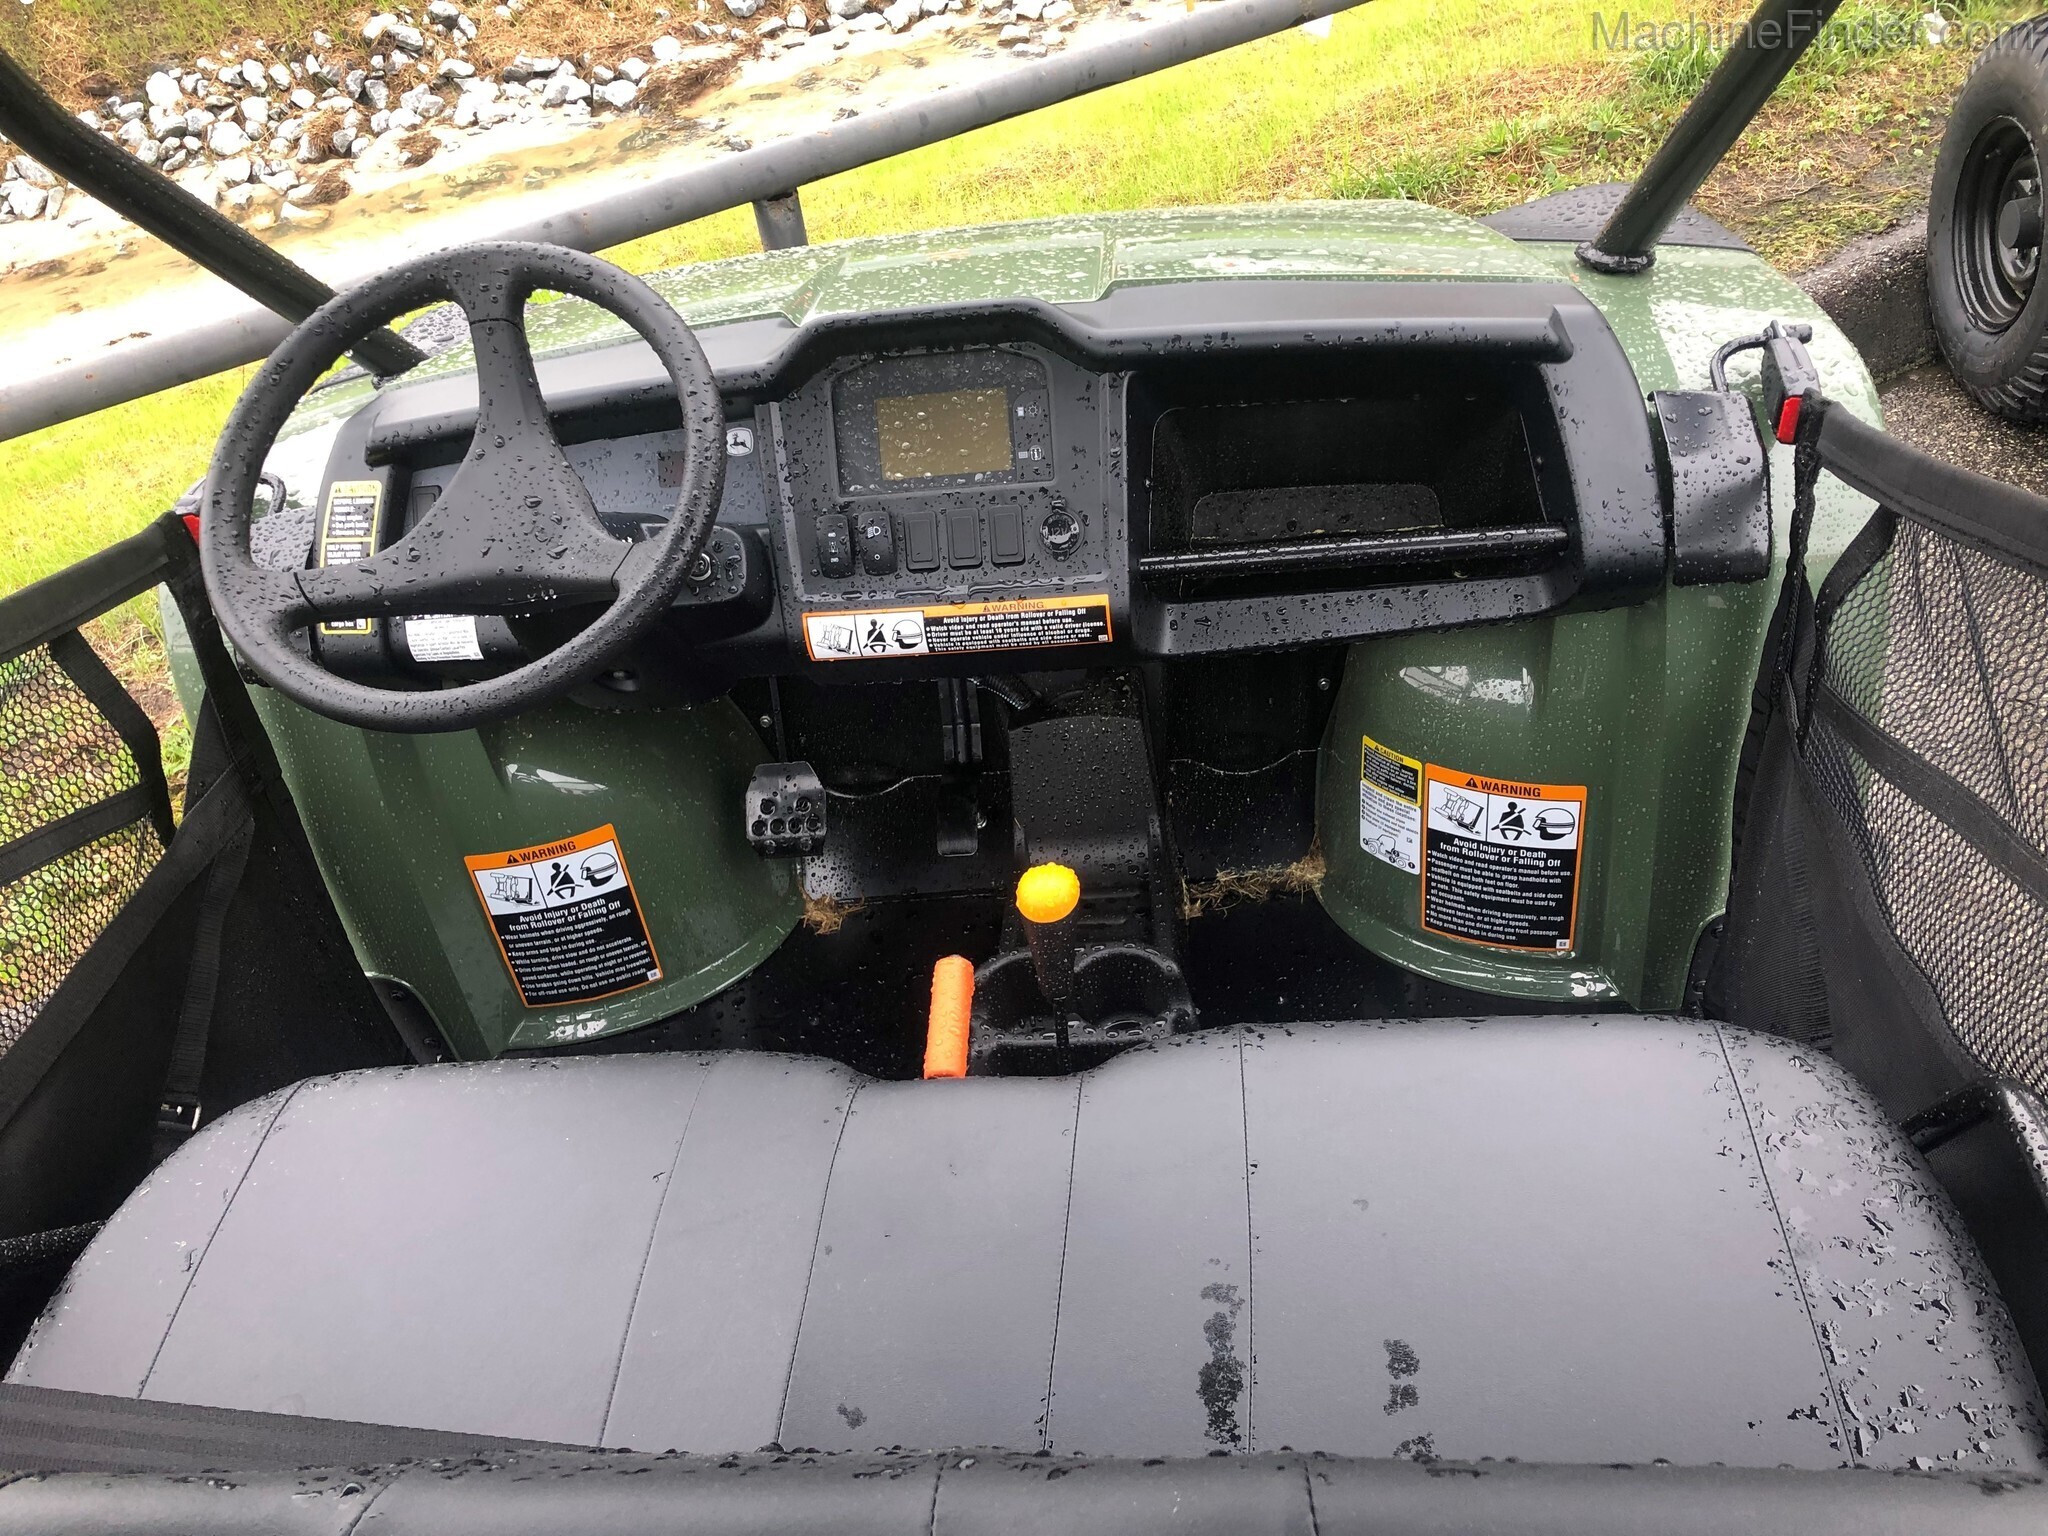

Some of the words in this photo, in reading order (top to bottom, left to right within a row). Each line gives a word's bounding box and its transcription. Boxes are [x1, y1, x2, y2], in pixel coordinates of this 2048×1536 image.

[991, 601, 1044, 612] WARNING
[943, 616, 960, 624] Avoid
[960, 615, 978, 624] Injury
[986, 613, 1005, 621] Death
[990, 620, 1020, 629] operator's
[1380, 748, 1404, 763] CAUTION
[1480, 780, 1541, 798] WARNING
[519, 840, 576, 862] WARNING
[1440, 842, 1460, 854] from
[1462, 847, 1500, 861] Rollover
[1513, 856, 1545, 868] Falling
[1547, 859, 1561, 867] Off
[1453, 837, 1477, 850] Avoid
[1480, 843, 1506, 856] Injury
[1520, 849, 1547, 859] Death
[1431, 850, 1448, 860] Watch
[1448, 855, 1464, 864] video
[1488, 864, 1517, 873] operator's
[1431, 857, 1459, 870] Passenger
[1459, 866, 1473, 874] must
[1518, 875, 1548, 883] handholds
[1431, 866, 1452, 876] seatbelt
[1471, 875, 1484, 883] both
[1431, 873, 1450, 884] Vehicle
[1456, 881, 1482, 891] equipped
[1495, 888, 1521, 897] seatbelts
[509, 923, 529, 931] from
[529, 917, 565, 929] Rollover
[567, 914, 576, 922] or
[577, 906, 608, 920] Falling
[608, 900, 621, 911] Off
[519, 912, 543, 923] Avoid
[543, 908, 568, 919] Injury
[570, 906, 579, 914] or
[580, 898, 606, 911] Death
[1438, 913, 1452, 922] more
[1452, 916, 1465, 924] than
[1430, 917, 1443, 927] Keep
[1443, 922, 1457, 930] arms
[1487, 931, 1506, 940] during
